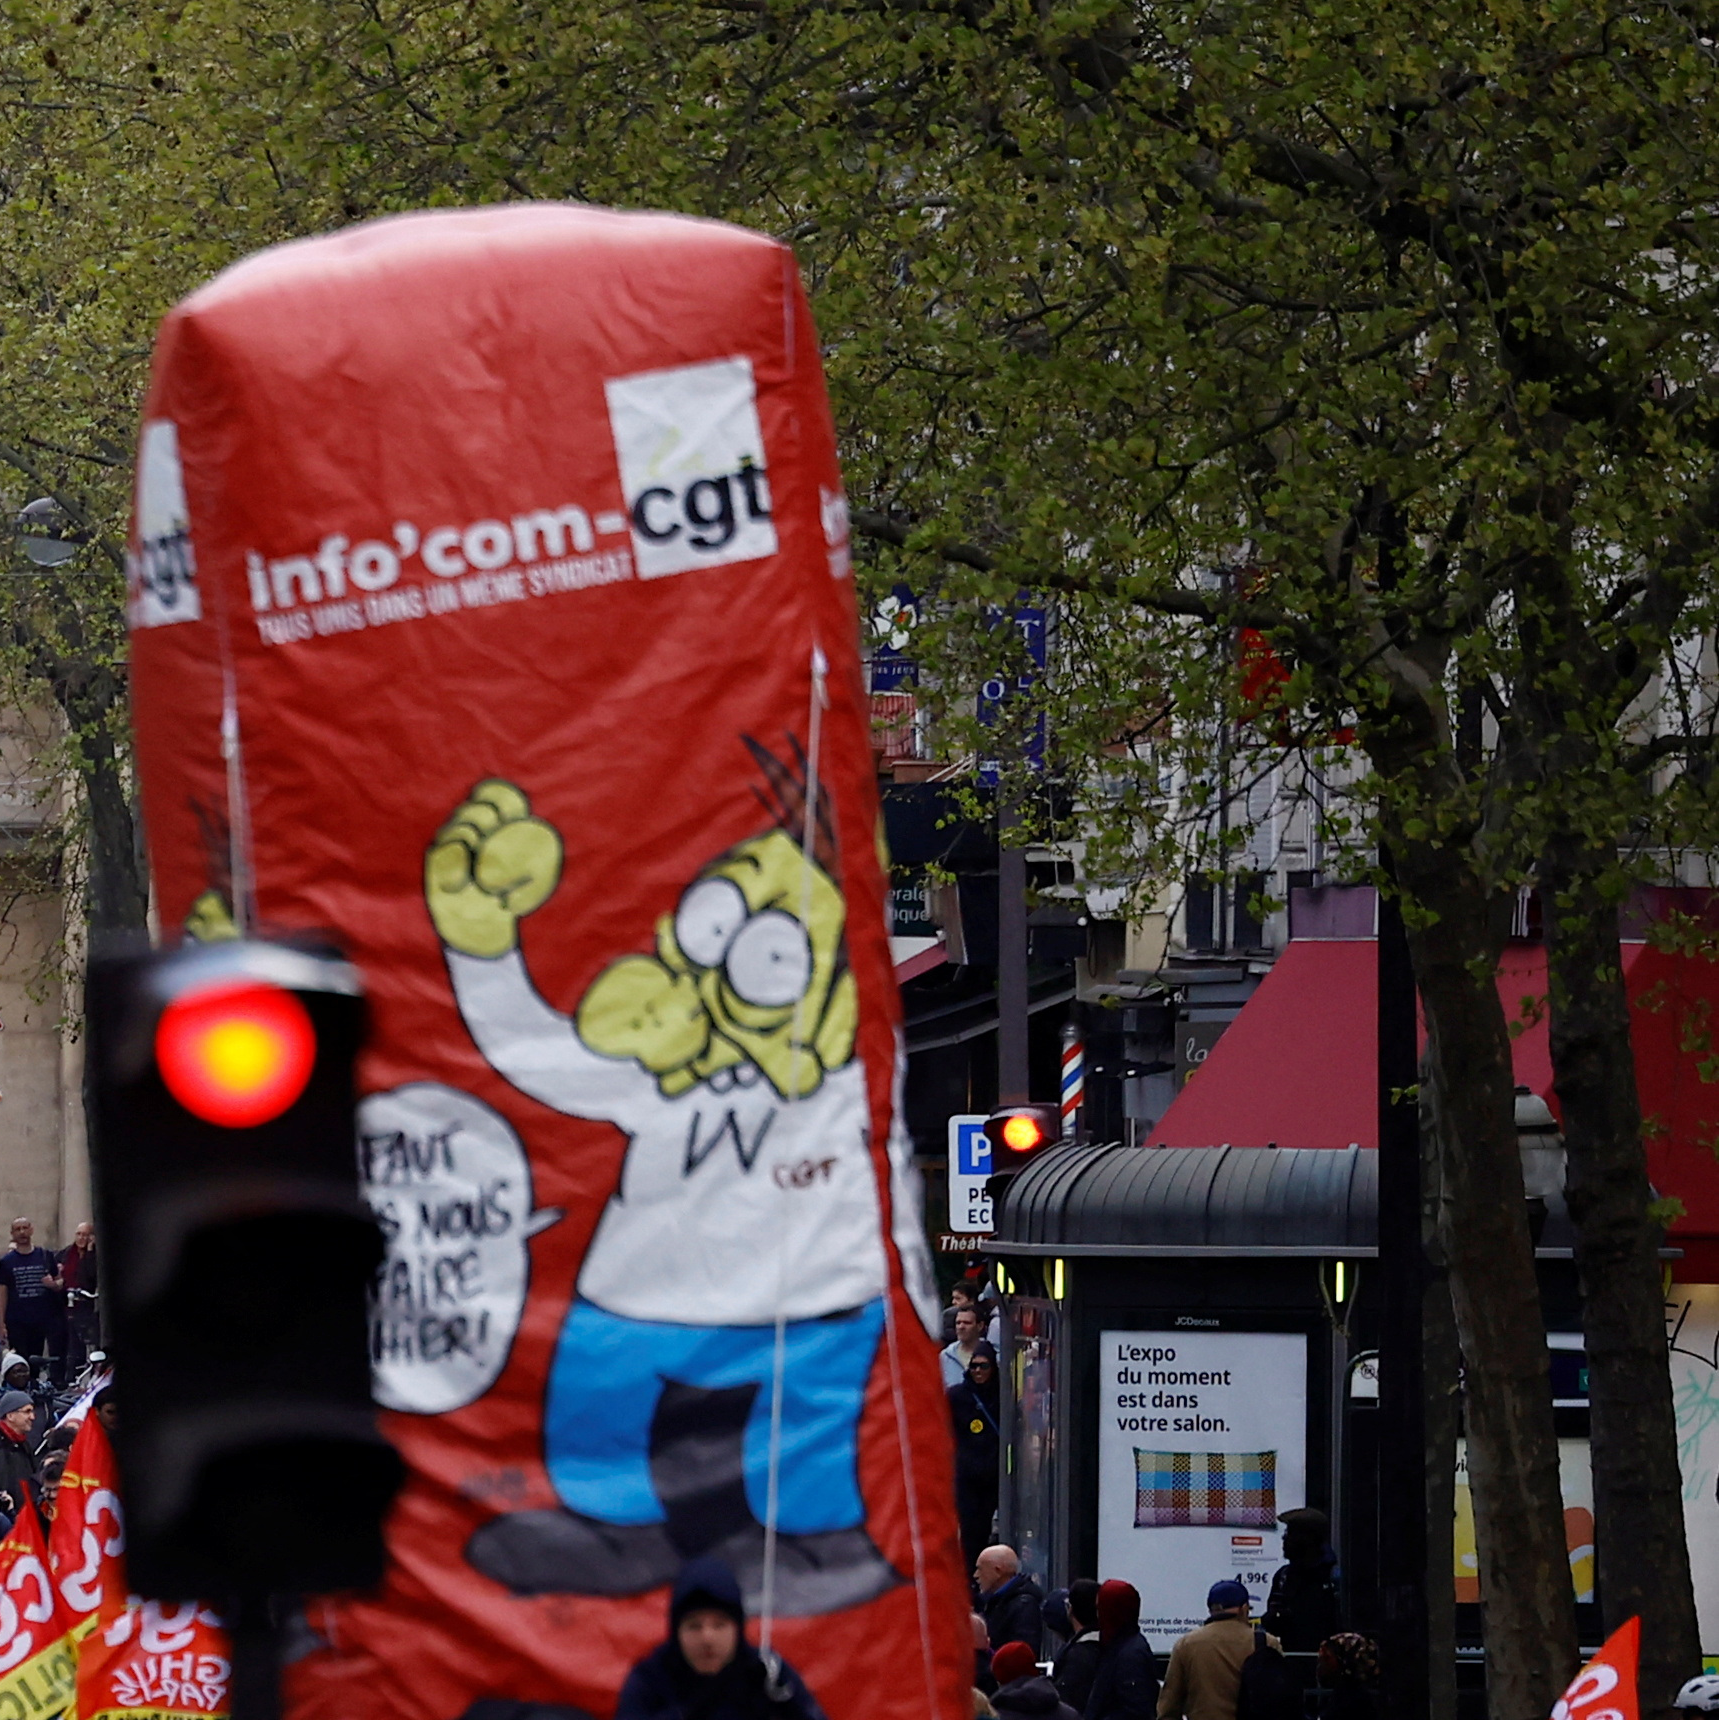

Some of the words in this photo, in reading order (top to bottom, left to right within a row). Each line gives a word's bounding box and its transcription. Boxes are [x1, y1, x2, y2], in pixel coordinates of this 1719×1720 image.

[311, 602, 364, 637] UNIS
[424, 581, 459, 615] UN
[526, 550, 634, 598] SYNDICAT
[970, 1132, 992, 1168] P
[419, 1181, 510, 1240] NOUS
[968, 1209, 990, 1224] EC
[1175, 1316, 1220, 1327] JCDecaux
[1117, 1344, 1177, 1366] L'expo
[1117, 1367, 1142, 1385] du
[1148, 1369, 1231, 1386] moment
[1117, 1392, 1146, 1409] est
[1152, 1390, 1199, 1409] dans
[1117, 1417, 1168, 1432] votre
[1173, 1414, 1231, 1433] salon.
